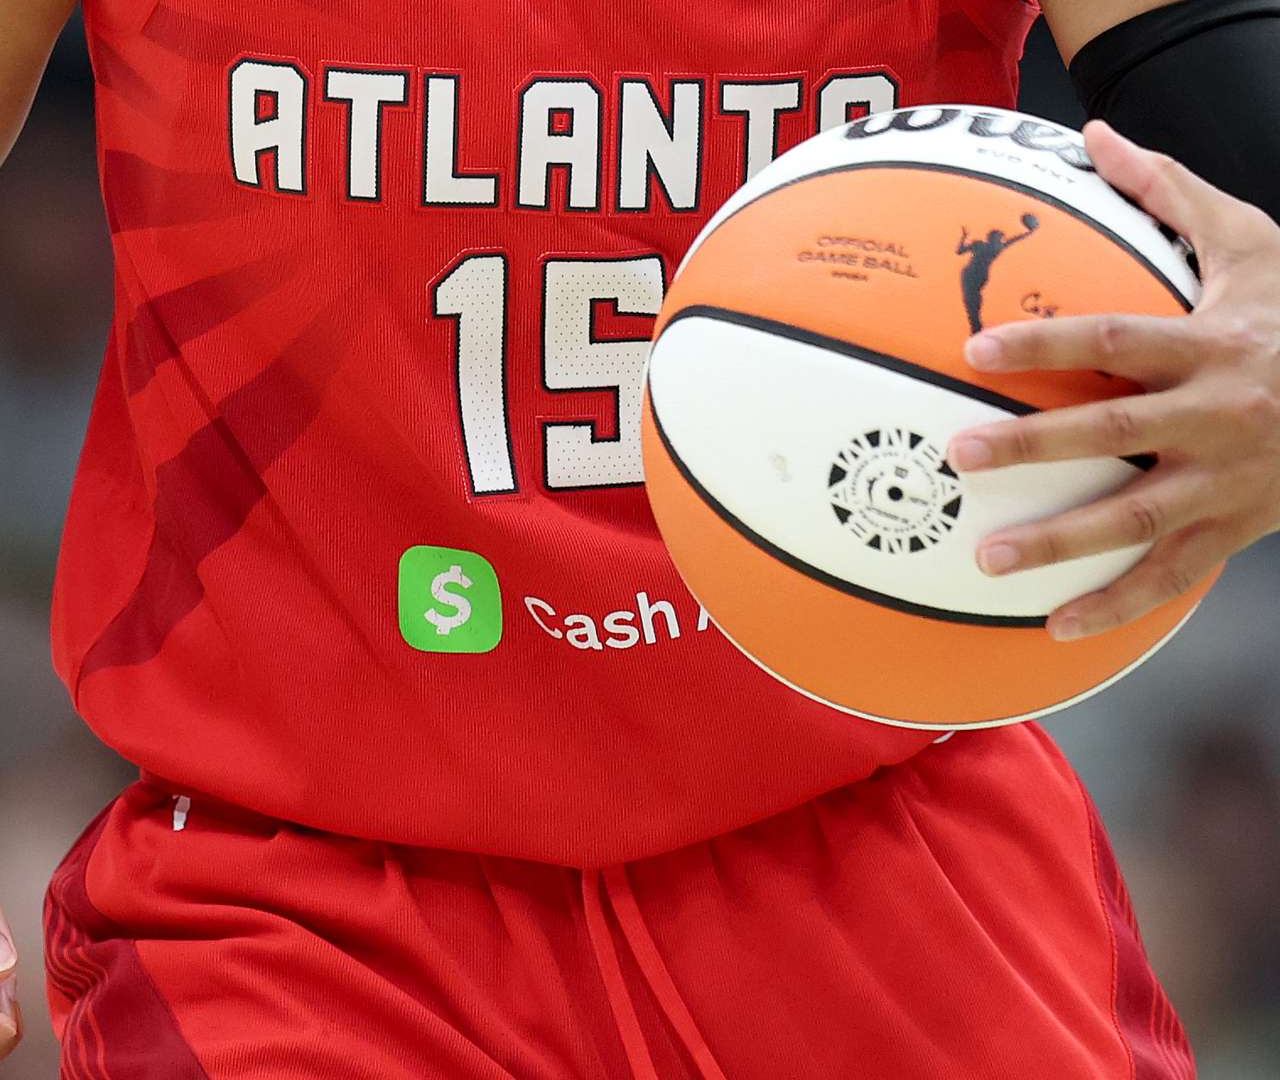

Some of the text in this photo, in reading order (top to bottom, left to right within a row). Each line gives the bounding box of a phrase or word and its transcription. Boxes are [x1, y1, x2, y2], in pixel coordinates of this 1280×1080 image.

[798, 250, 859, 266] GAME
[862, 255, 919, 279] BALL
[433, 252, 668, 498] 15
[524, 591, 681, 651] Cash
